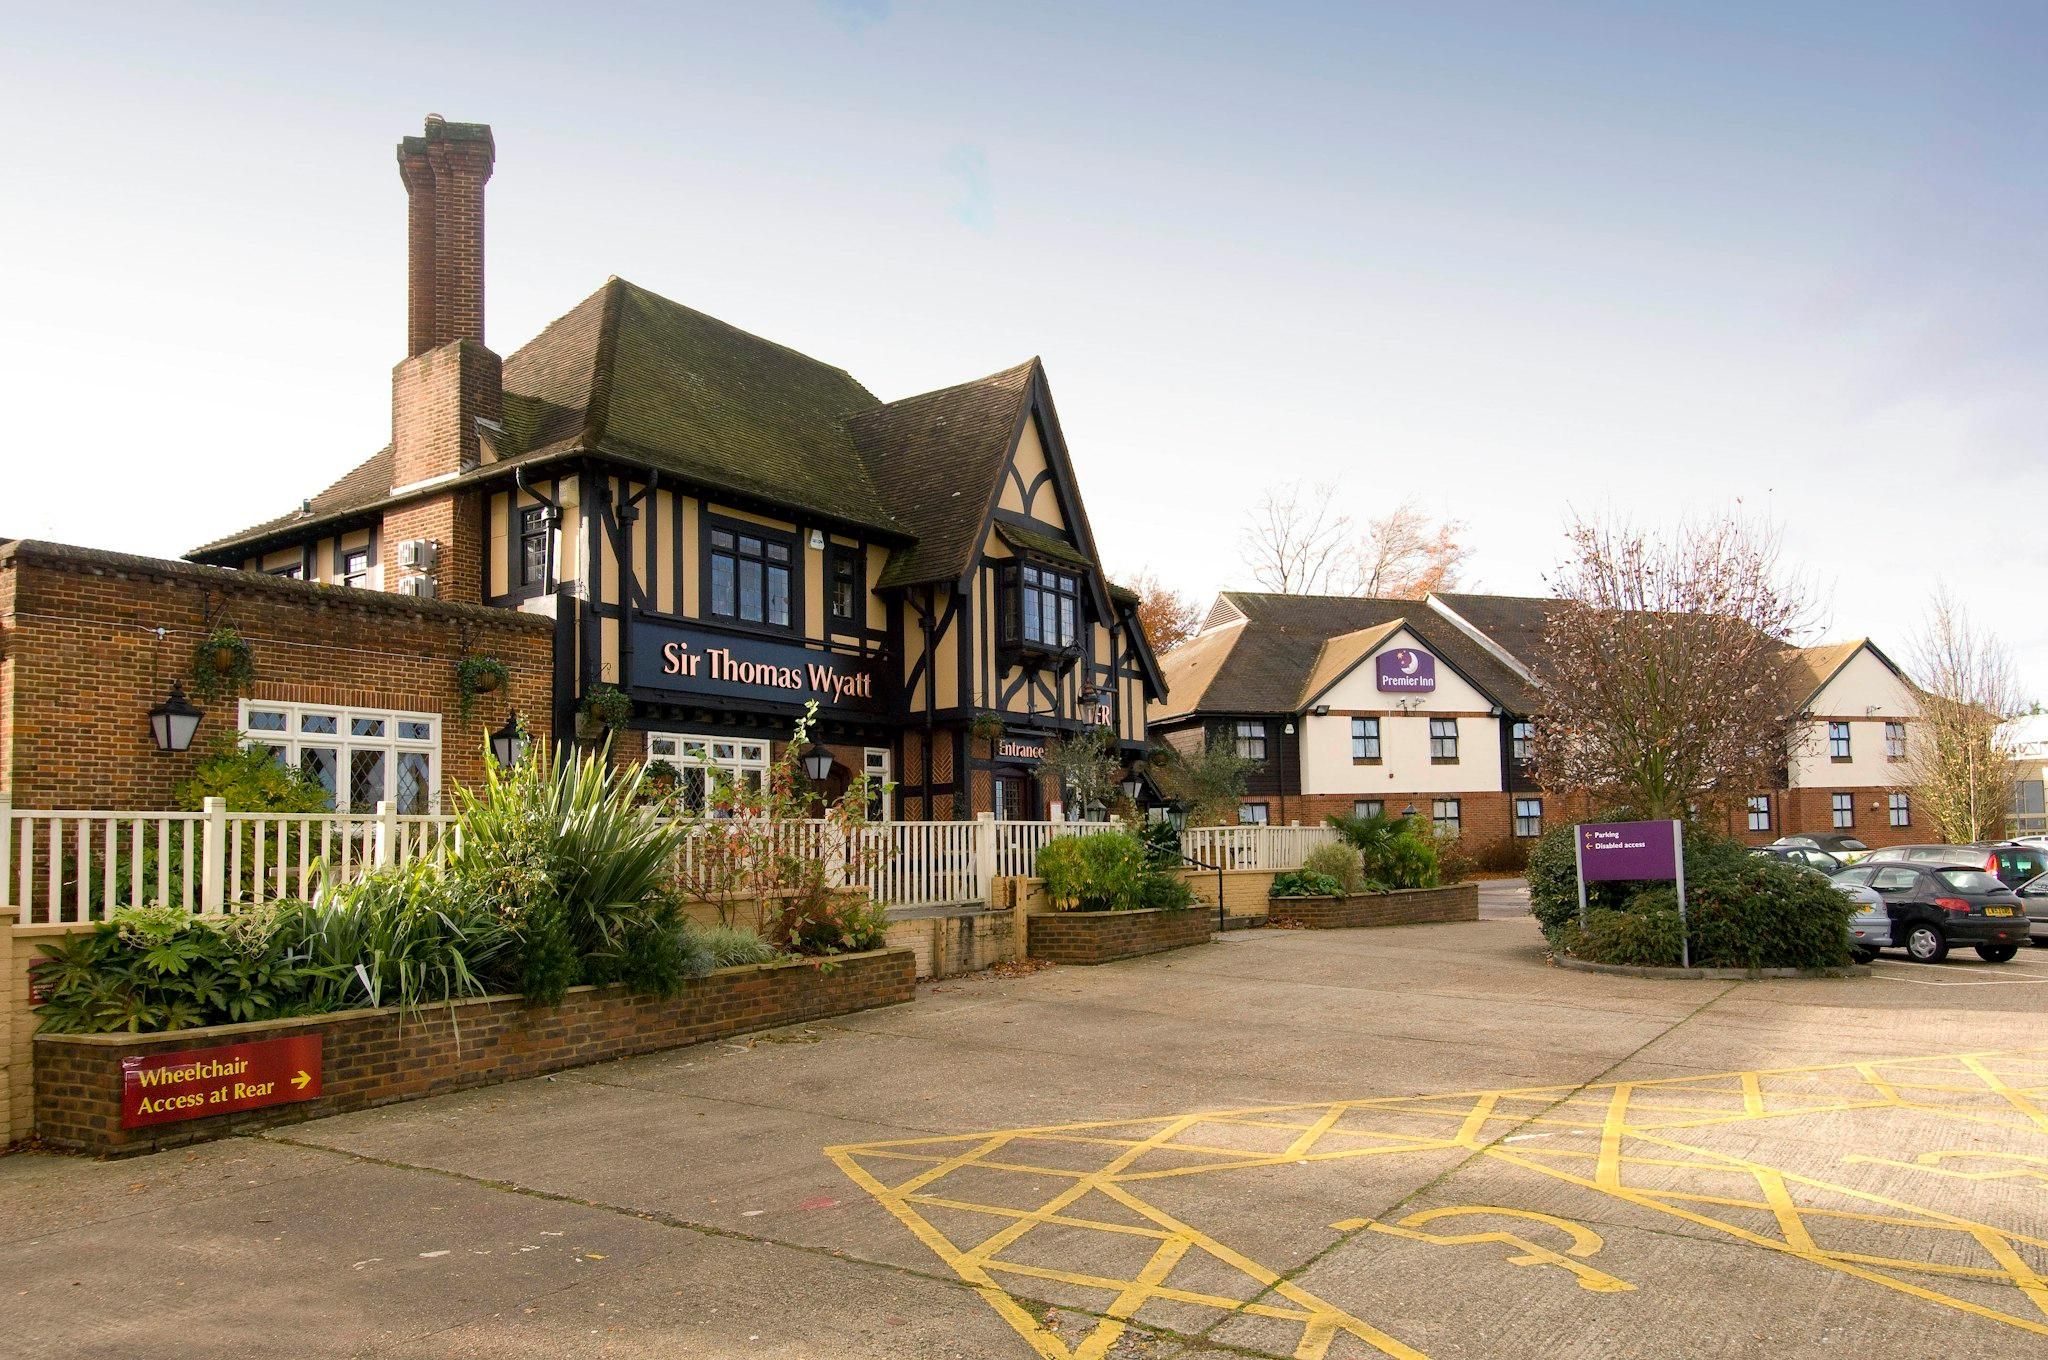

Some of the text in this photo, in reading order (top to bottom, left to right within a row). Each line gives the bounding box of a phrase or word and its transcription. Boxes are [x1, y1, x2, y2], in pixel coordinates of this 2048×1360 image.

[663, 642, 873, 704] Sir Thomas Wyatt
[1382, 675, 1434, 686] Premier Inn
[999, 739, 1045, 759] Entrance
[1594, 831, 1620, 839] Parking
[1595, 842, 1623, 850] Disabled
[138, 1056, 249, 1088] Wheelchair
[137, 1080, 275, 1115] Access at Rear
